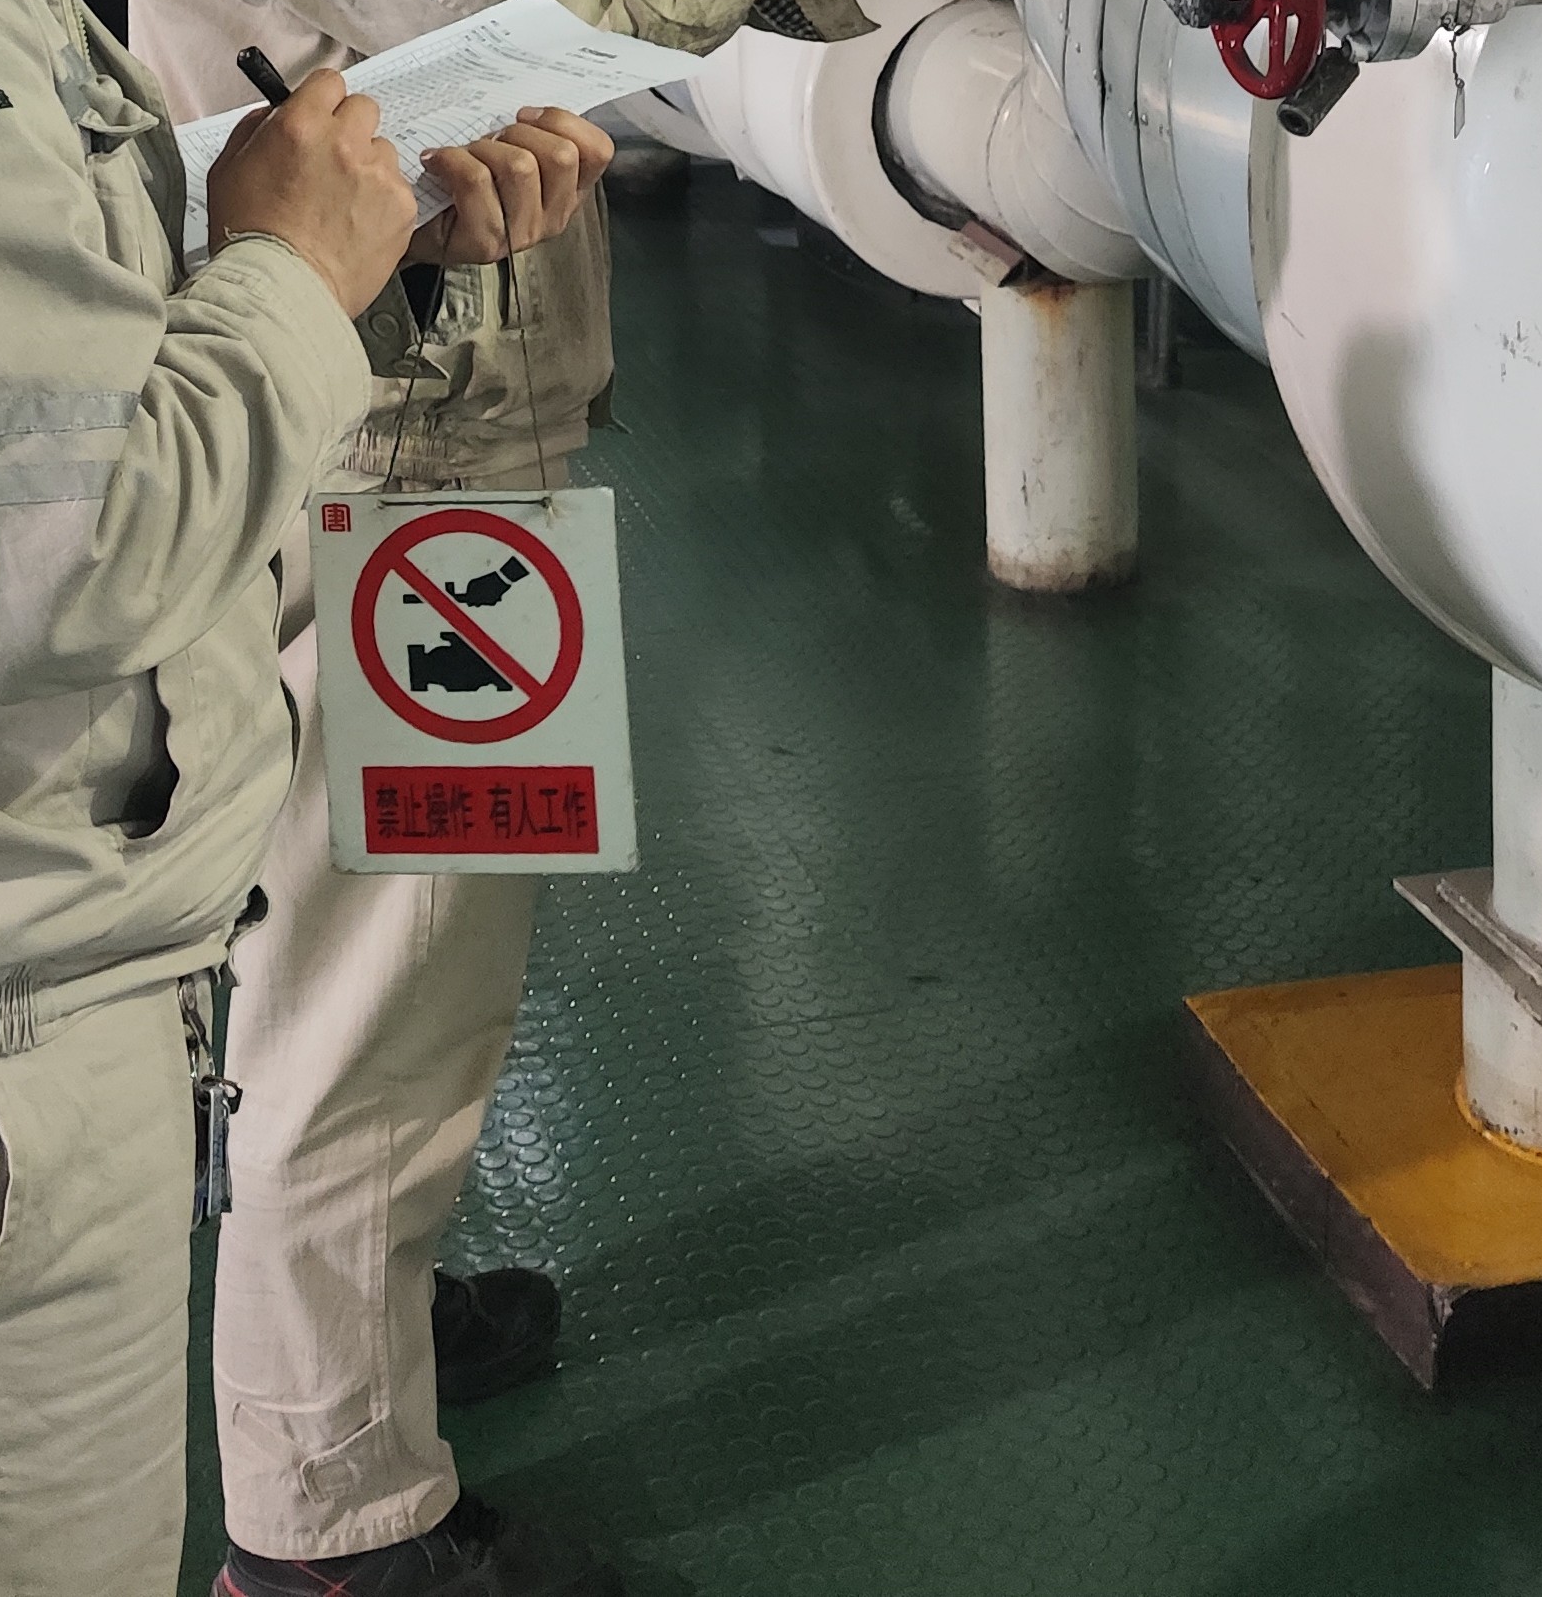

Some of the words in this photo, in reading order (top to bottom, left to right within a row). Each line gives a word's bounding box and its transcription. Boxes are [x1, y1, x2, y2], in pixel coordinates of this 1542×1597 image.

[376, 782, 474, 839] 禁止操作
[487, 782, 589, 839] 有人工作
